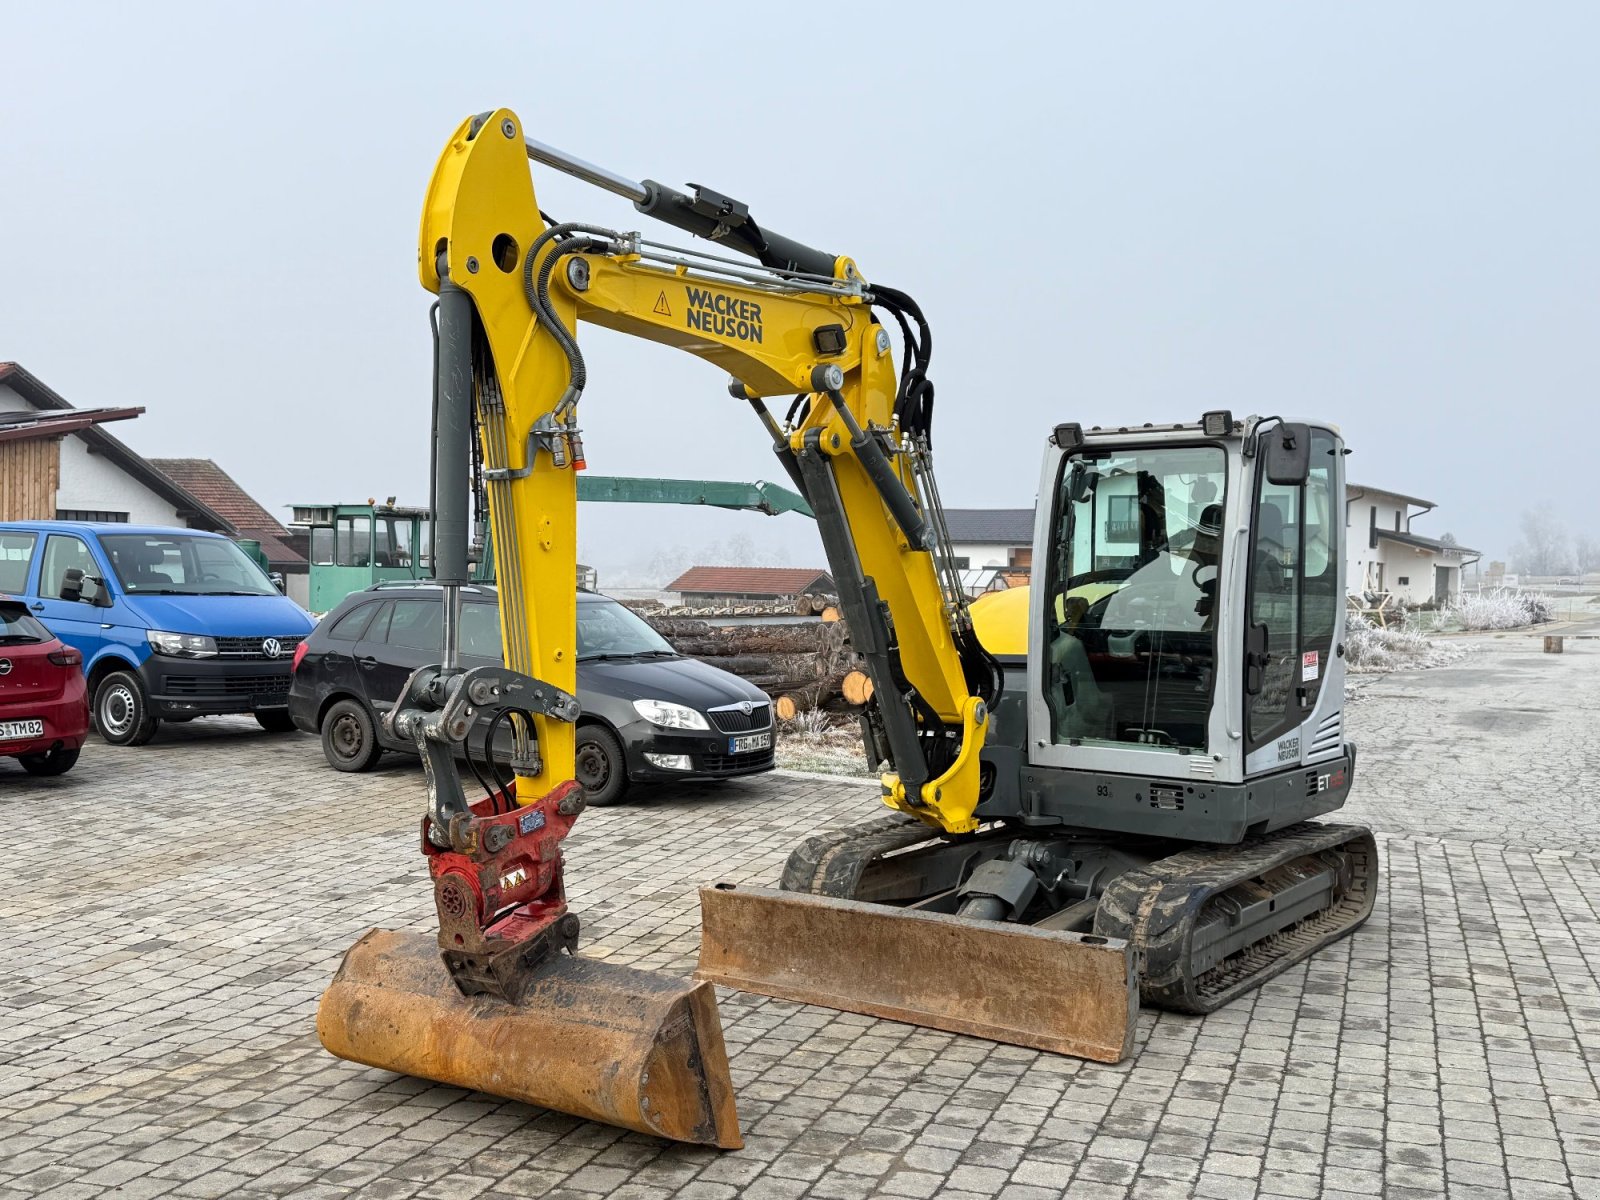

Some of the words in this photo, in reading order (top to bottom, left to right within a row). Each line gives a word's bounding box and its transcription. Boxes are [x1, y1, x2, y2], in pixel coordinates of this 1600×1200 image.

[685, 286, 763, 324] WACKER
[687, 308, 763, 344] NEUSON
[11, 722, 27, 735] TM
[29, 721, 42, 733] 82
[735, 738, 748, 751] FRG
[1277, 737, 1299, 751] WACKER
[1278, 747, 1299, 762] NEUSON
[1317, 773, 1331, 791] ET
[1096, 785, 1109, 796] 93
